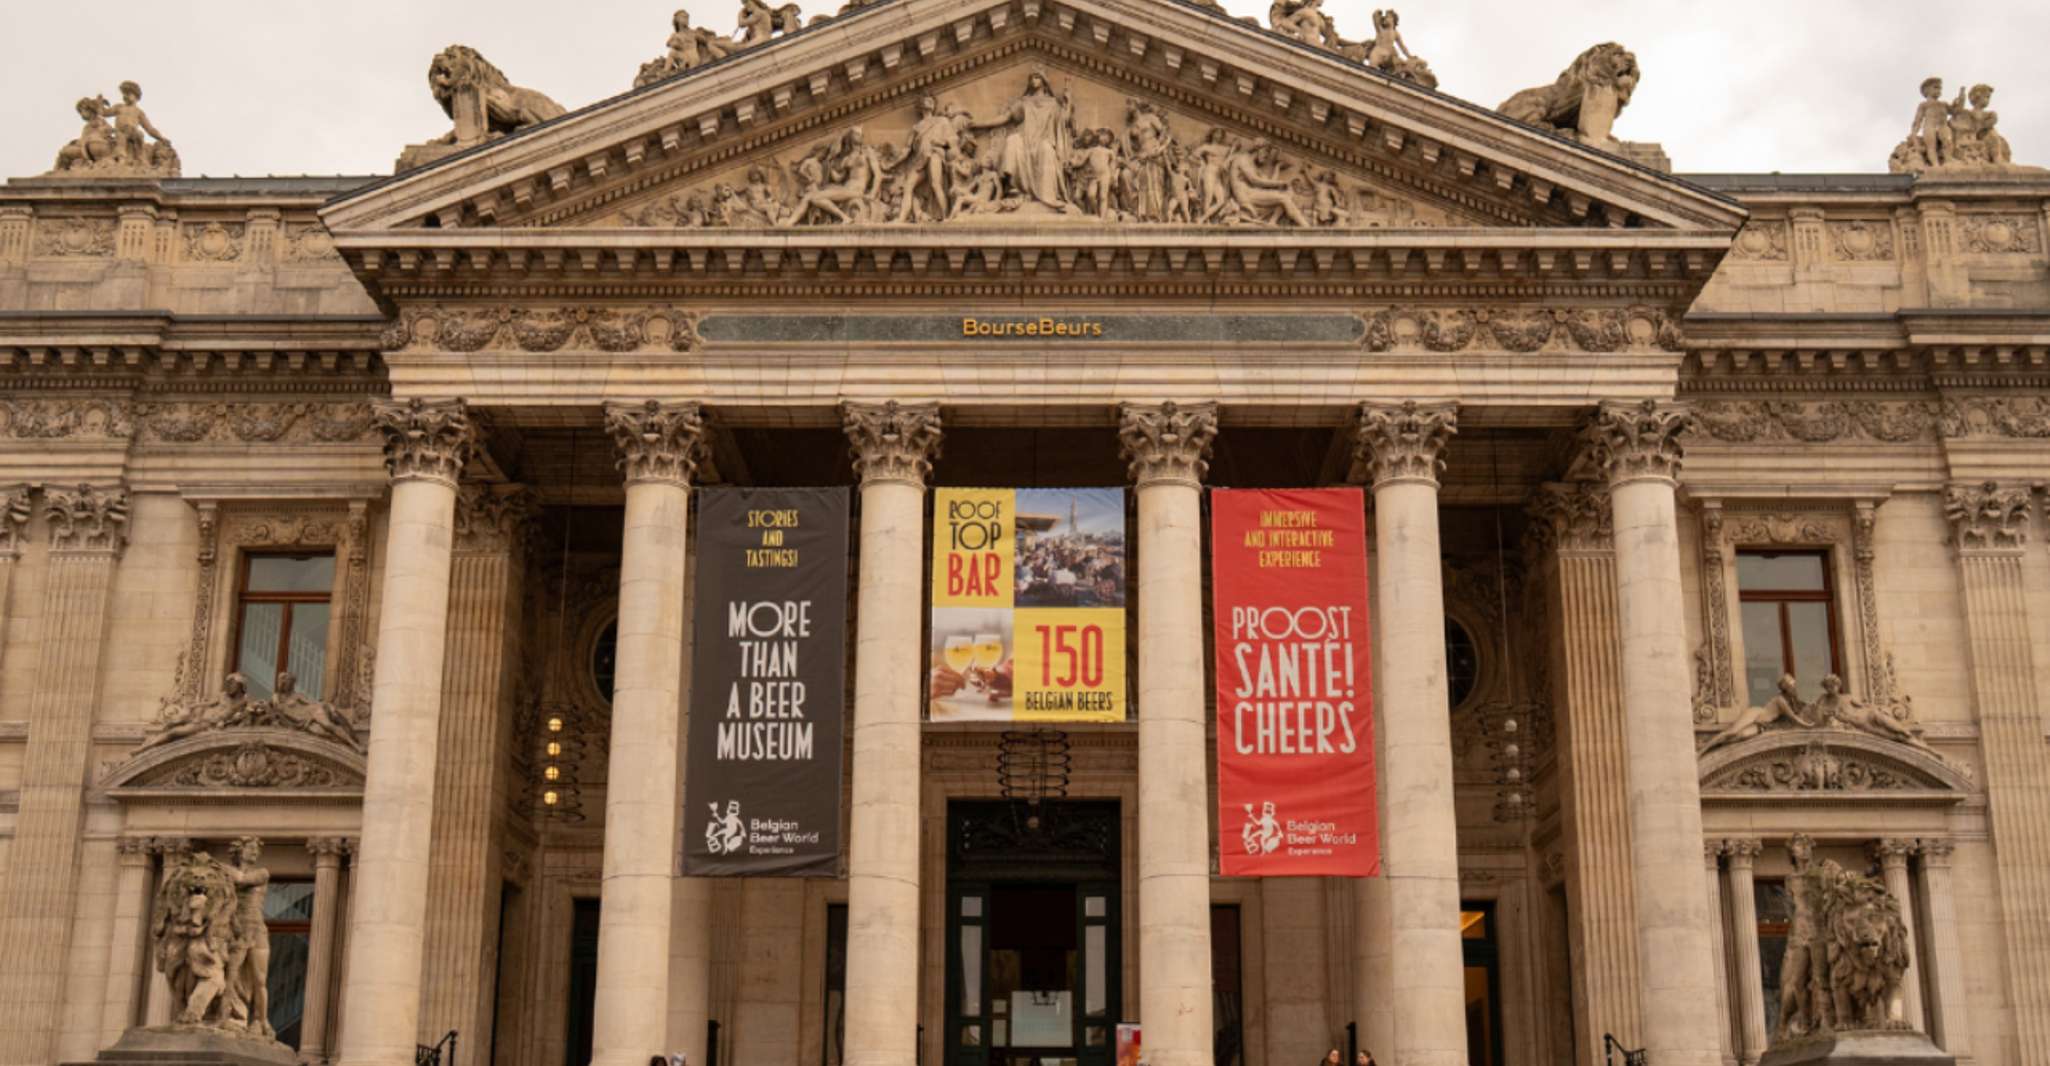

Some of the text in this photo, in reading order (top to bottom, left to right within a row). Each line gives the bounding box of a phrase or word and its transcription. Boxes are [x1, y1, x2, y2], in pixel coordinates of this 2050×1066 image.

[962, 318, 1102, 335] BourseBeurs
[747, 510, 799, 527] STORIES
[949, 500, 1002, 520] ROOF
[1260, 511, 1317, 528] IMMERSIVE
[762, 529, 783, 547] AND
[949, 521, 1002, 550] TOP
[1244, 530, 1334, 547] AND INTERACTIVE
[746, 549, 798, 568] TASTINGS!
[1259, 550, 1321, 567] EXPERIENCE
[947, 552, 1002, 597] BAR
[729, 600, 811, 638] MORE
[1232, 606, 1351, 640] PROOST
[739, 642, 797, 677] THAN
[1035, 624, 1104, 688] 150
[1234, 637, 1355, 698] SANTÉ!
[726, 682, 806, 719] A BEER
[1077, 691, 1113, 711] BEERS
[1235, 701, 1357, 755] CHEERS
[716, 722, 813, 760] MUSEUM
[750, 818, 799, 833] Belgian
[1287, 820, 1335, 834] Belgian
[750, 832, 819, 843] Beer World
[1287, 833, 1357, 844] Beer World
